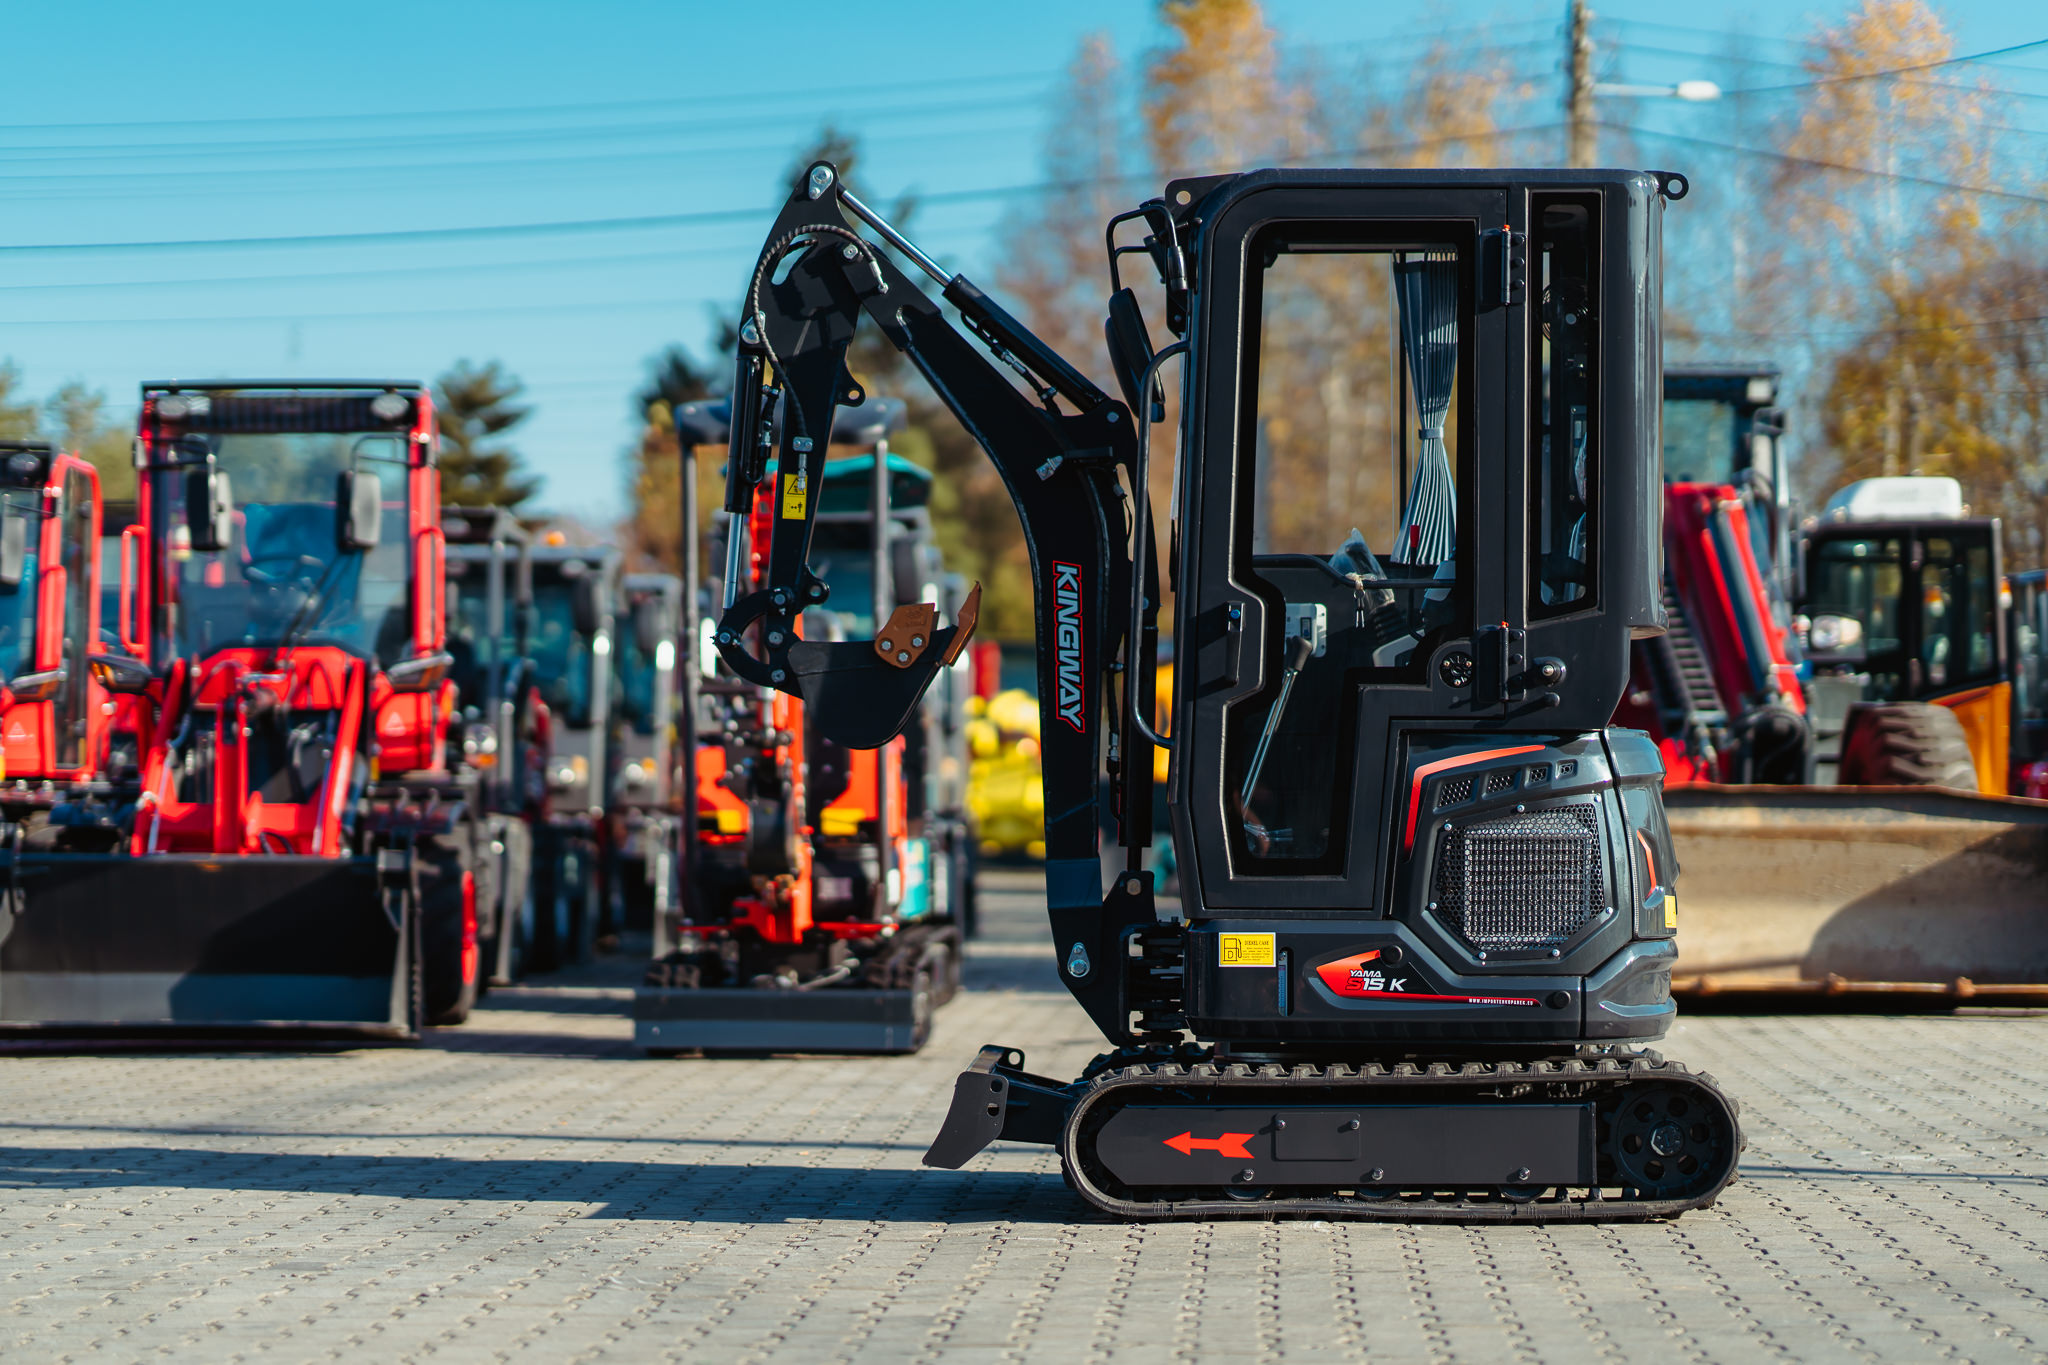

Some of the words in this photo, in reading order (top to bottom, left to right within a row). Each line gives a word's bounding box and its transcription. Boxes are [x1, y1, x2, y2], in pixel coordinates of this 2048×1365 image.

[1056, 564, 1082, 729] KINGWAY
[1349, 970, 1382, 978] YAMA
[1389, 978, 1407, 991] K
